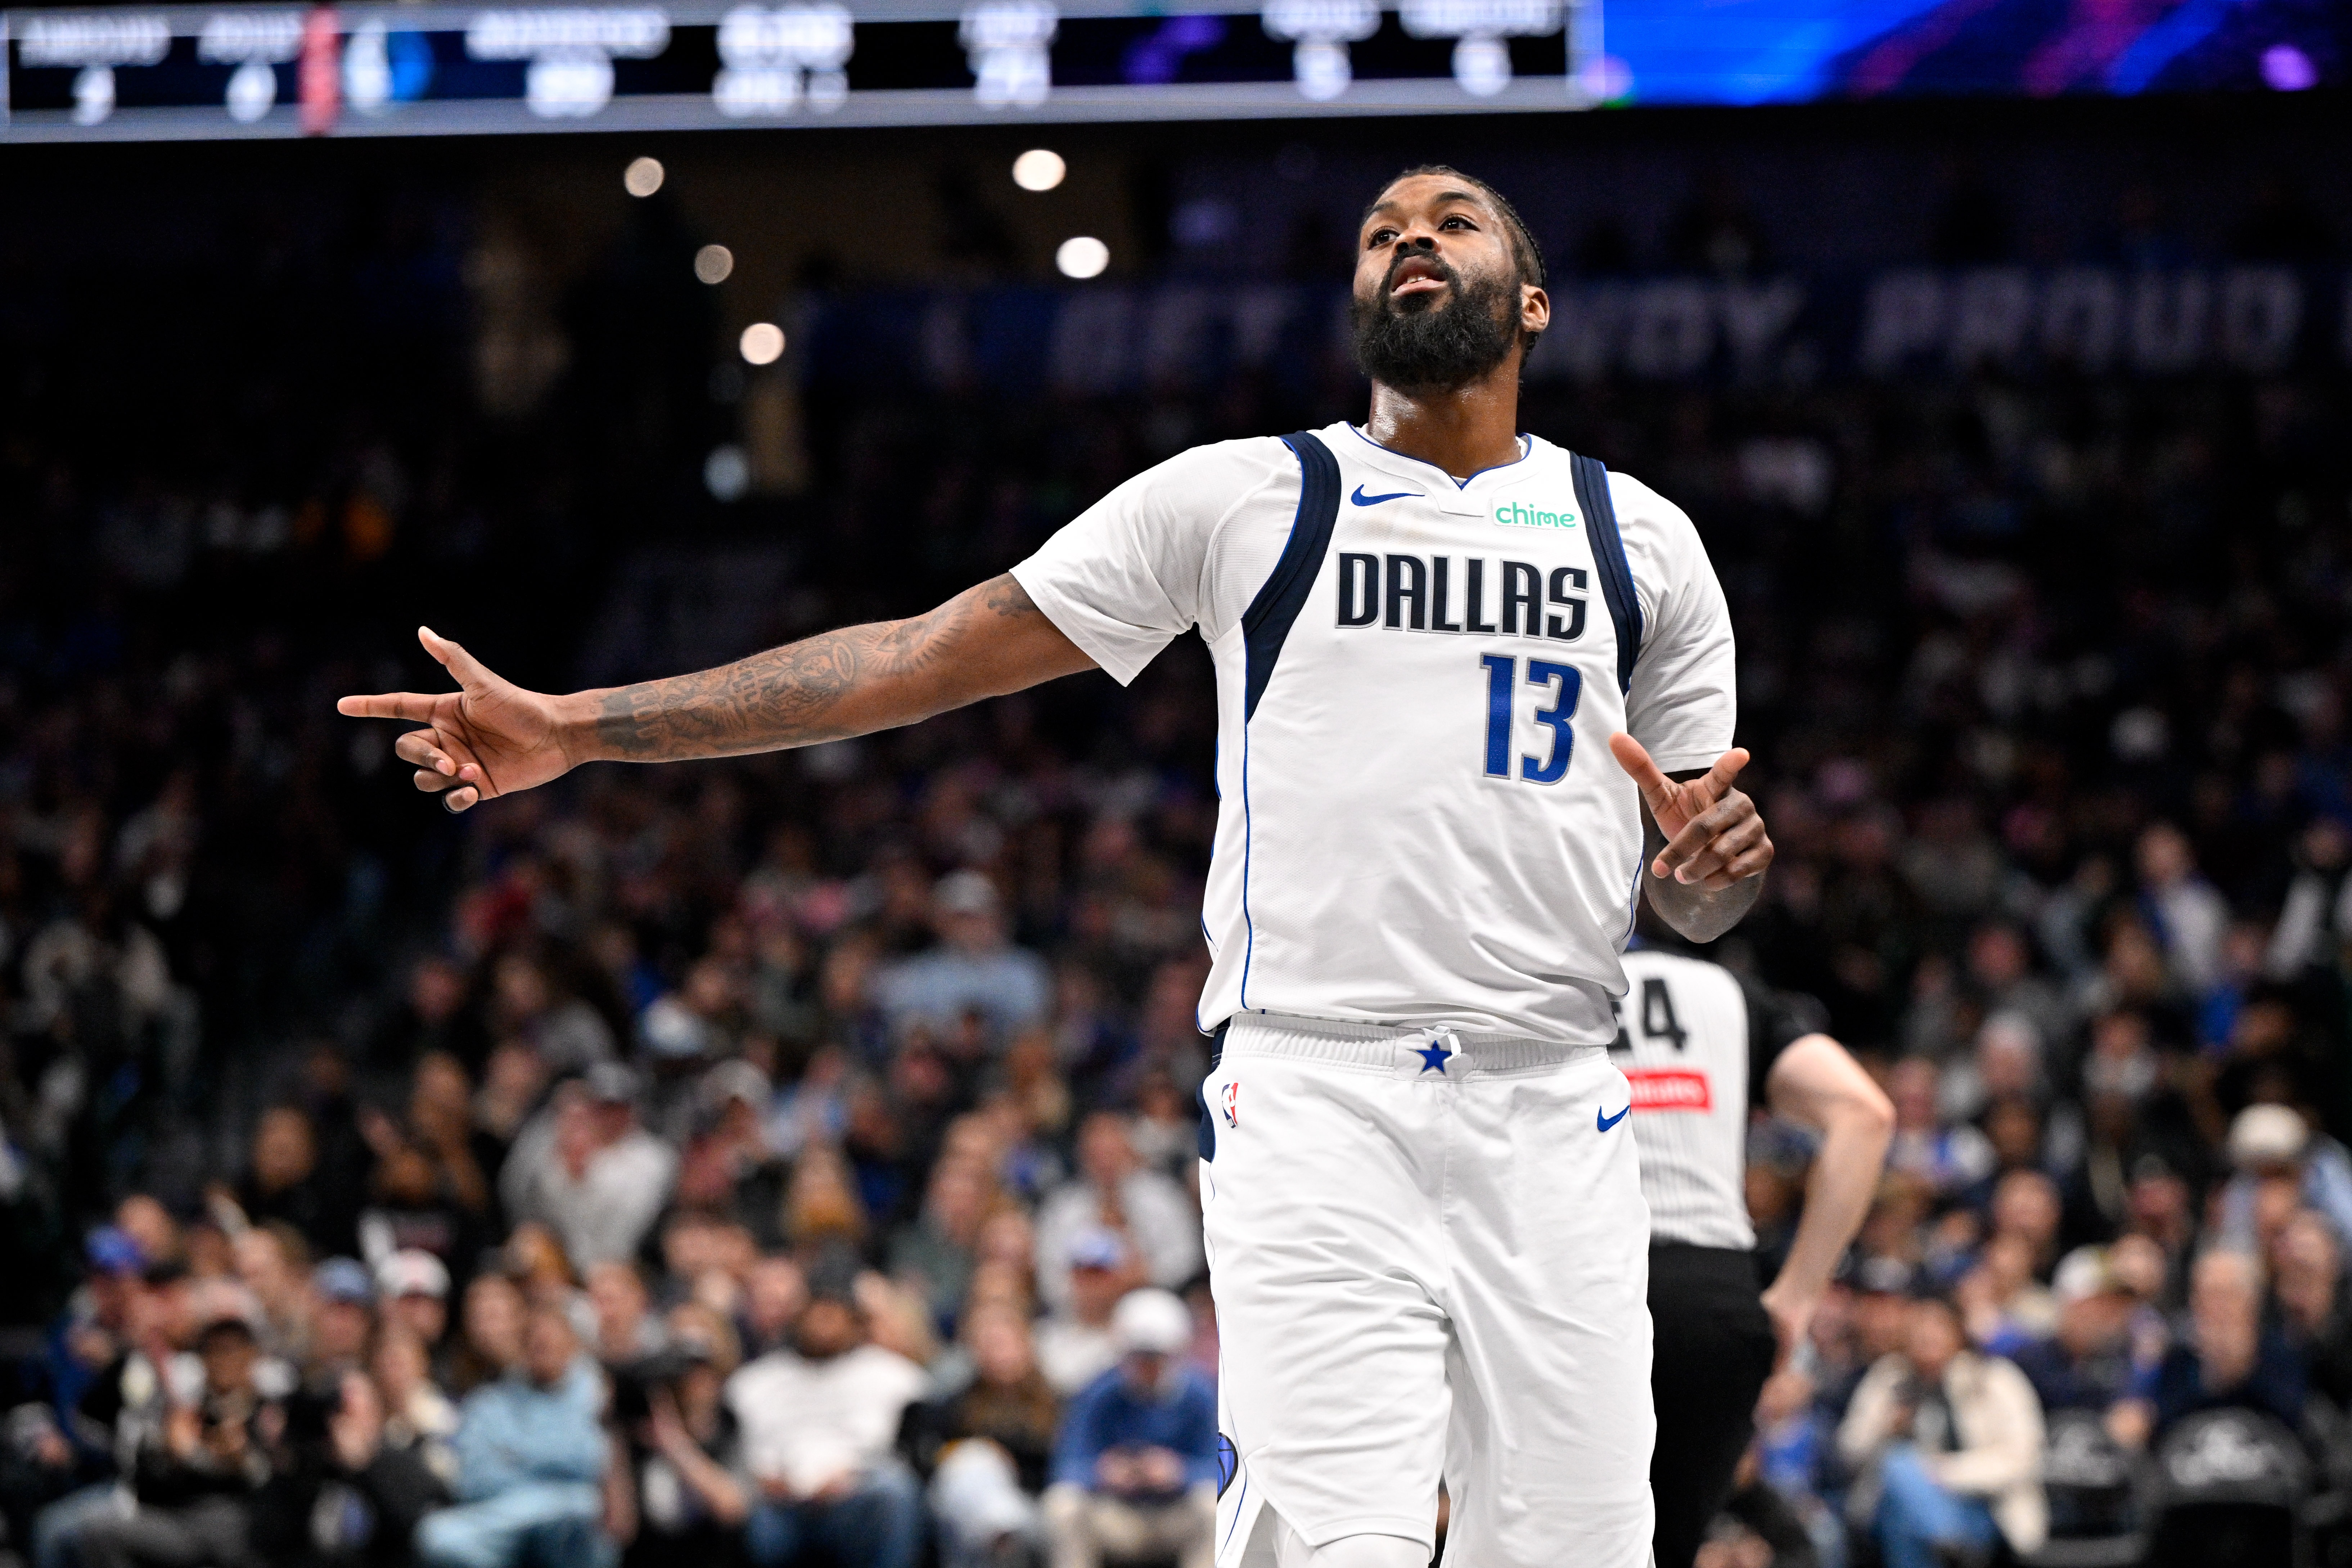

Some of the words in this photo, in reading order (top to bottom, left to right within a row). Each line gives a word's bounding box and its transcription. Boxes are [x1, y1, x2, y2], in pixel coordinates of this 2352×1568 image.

[1857, 266, 2303, 375] PROUD
[1495, 501, 1577, 528] chime
[1335, 551, 1589, 643] DALLAS
[1480, 652, 1583, 786] 13
